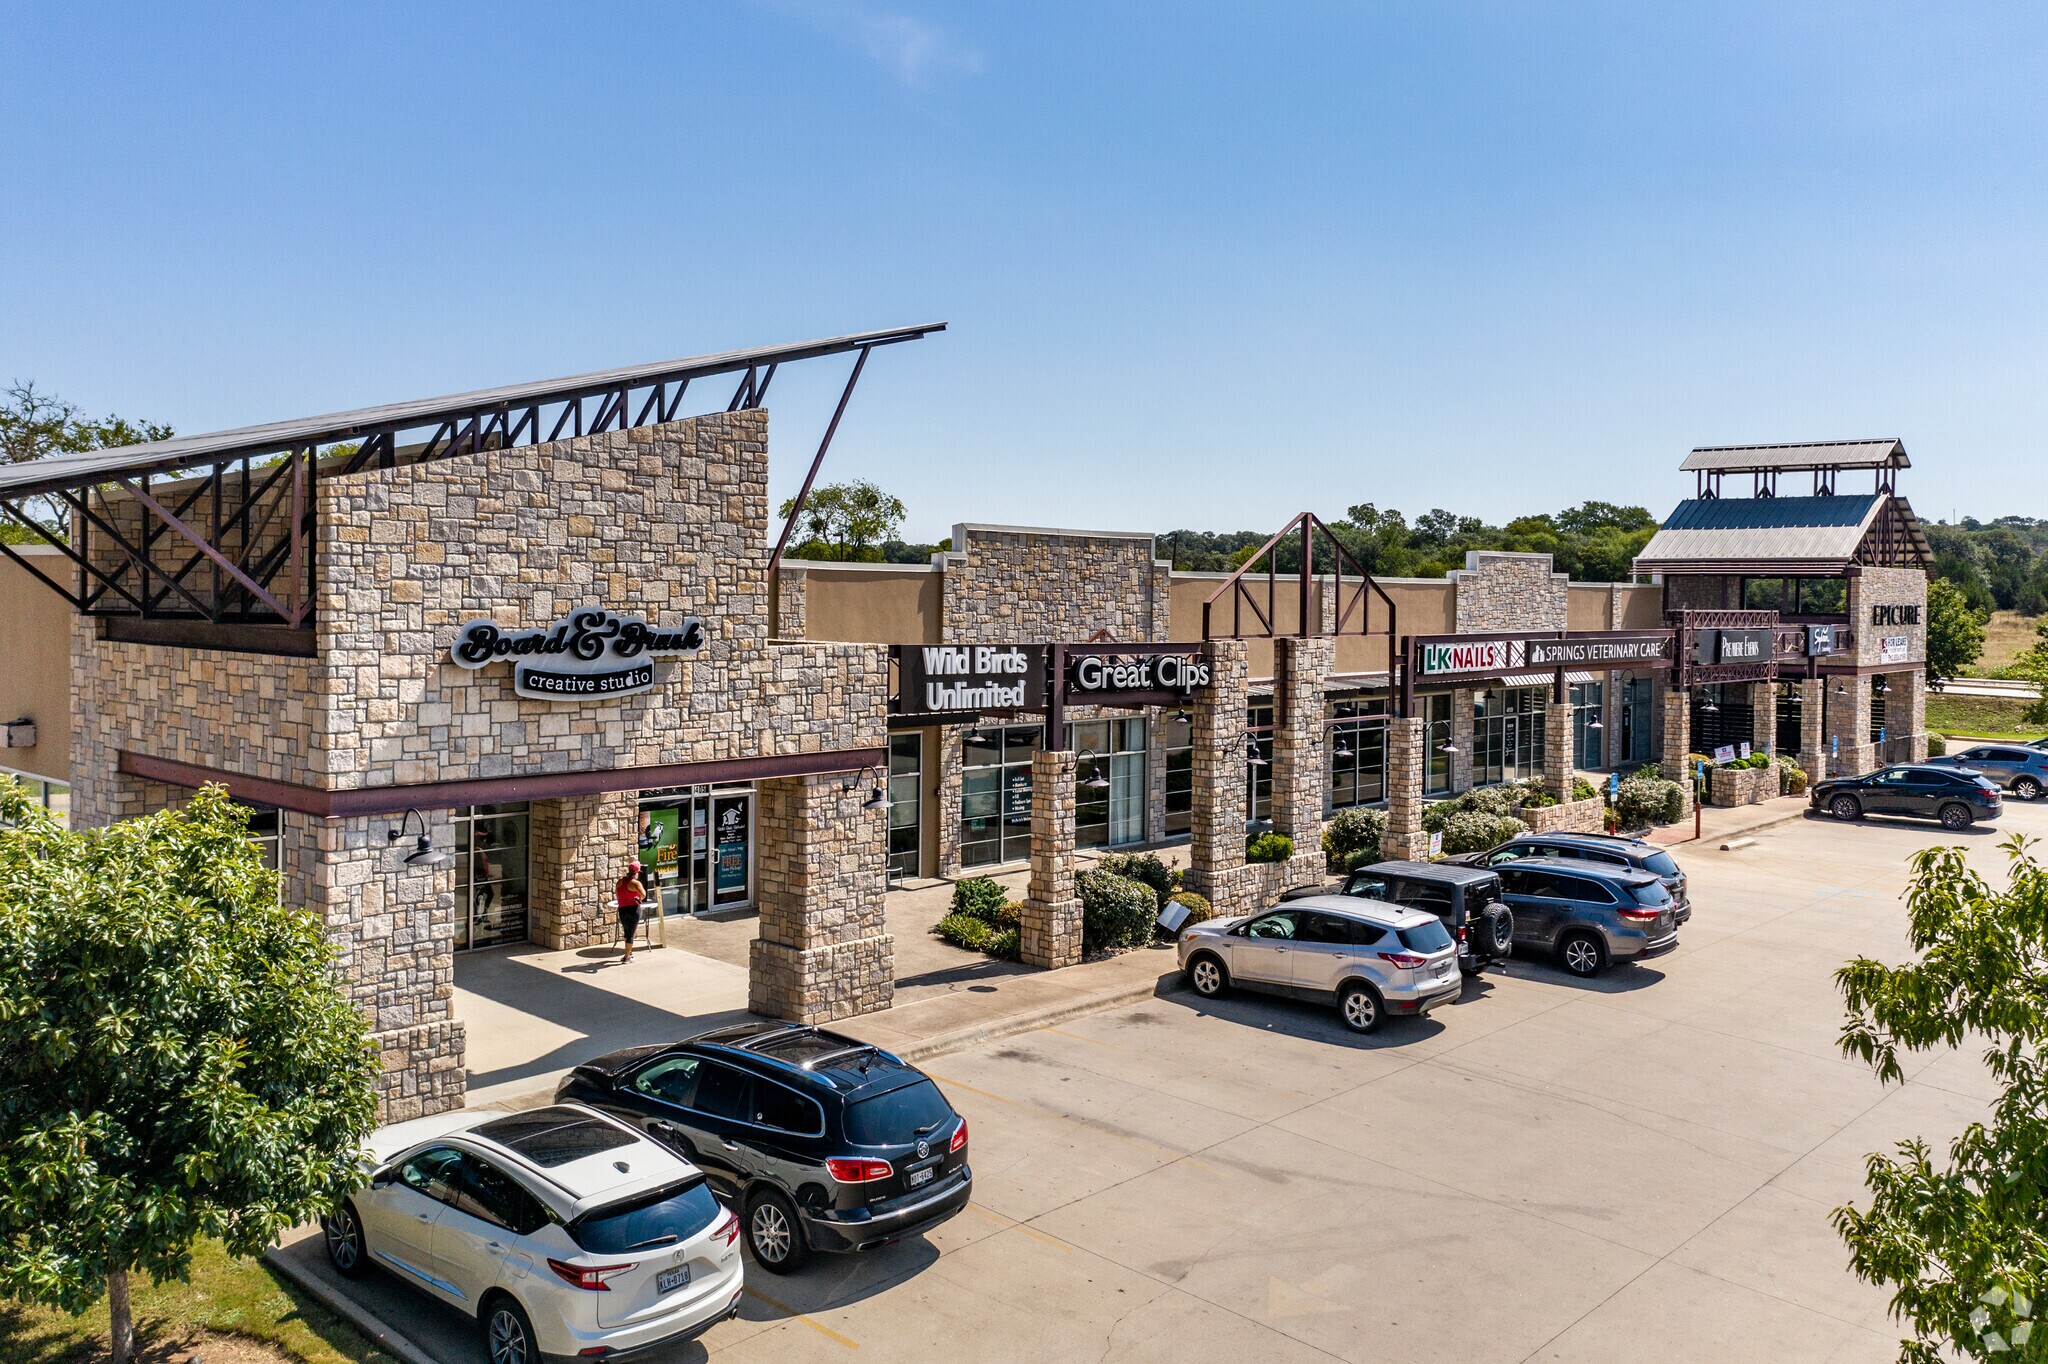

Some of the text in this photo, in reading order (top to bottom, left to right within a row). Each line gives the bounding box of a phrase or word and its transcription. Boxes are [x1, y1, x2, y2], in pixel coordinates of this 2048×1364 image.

[1873, 605, 1920, 625] EPICURE
[460, 625, 570, 663] Board
[1545, 642, 1661, 662] SPRINGS VETERINARY CARE
[922, 646, 1028, 676] Wild Birds
[1453, 645, 1495, 669] NAILS
[529, 671, 650, 692] creative studio
[1078, 655, 1210, 696] Great Clips
[925, 680, 1027, 711] Unlimited
[657, 847, 678, 862] Fire
